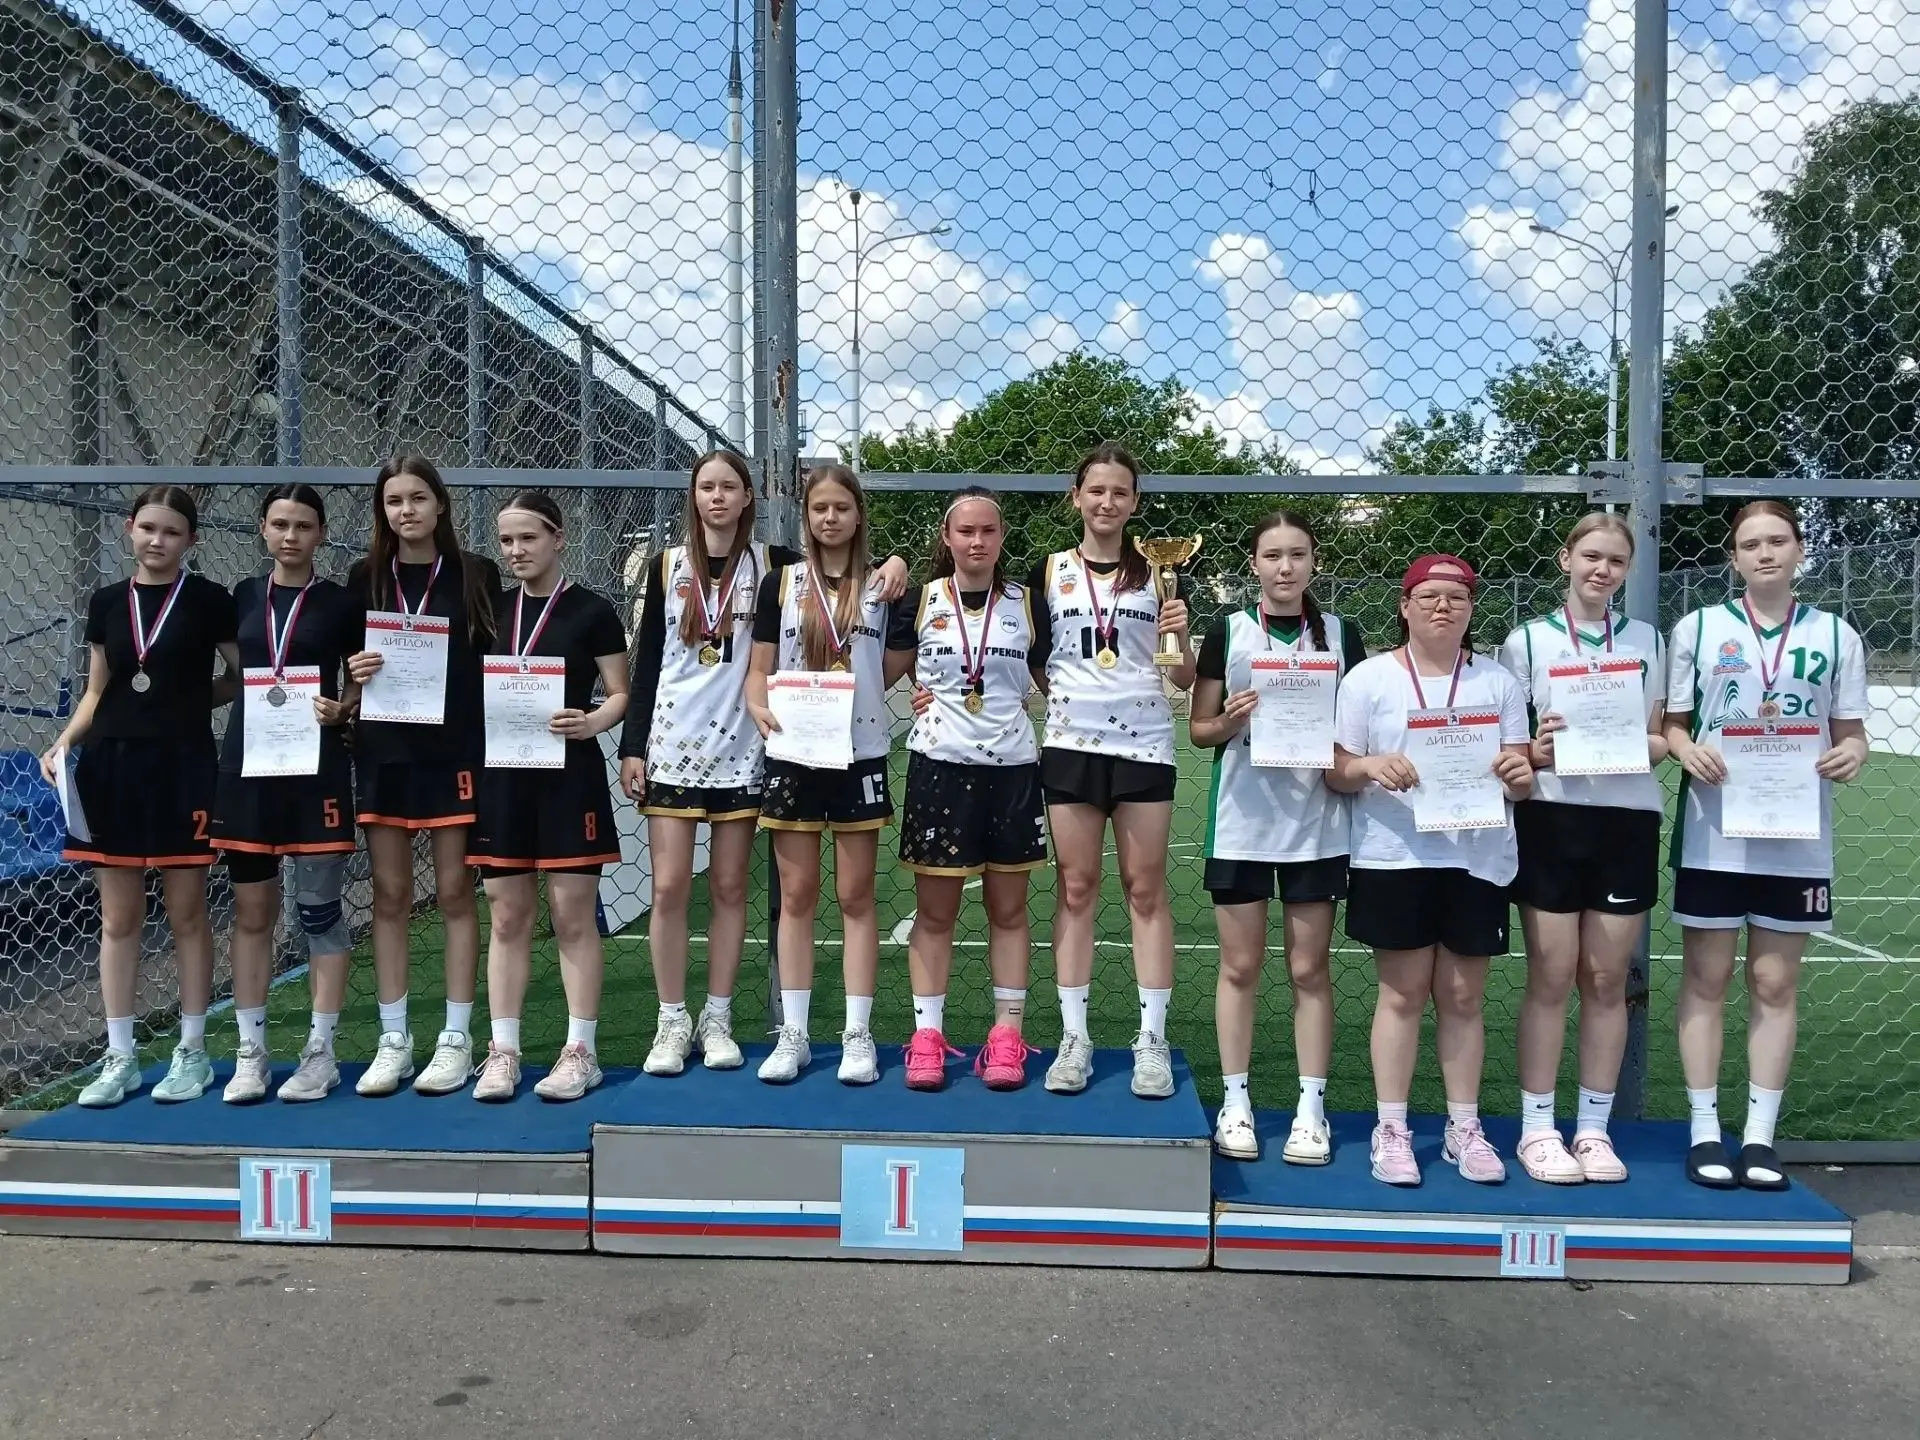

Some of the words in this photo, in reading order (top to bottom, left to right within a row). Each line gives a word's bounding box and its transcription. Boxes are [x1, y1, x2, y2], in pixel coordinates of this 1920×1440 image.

[1063, 608, 1083, 618] ИМ.
[380, 637, 434, 649] ДИПЛОМ
[936, 646, 957, 656] ИМ.
[1788, 647, 1828, 686] 12
[498, 681, 550, 692] ДИПЛОМ
[1266, 677, 1321, 688] ДИПЛОМ
[1567, 680, 1626, 695] ДИПЛОМ
[788, 693, 839, 704] ДИПЛОМ
[1425, 733, 1484, 746] ДИПЛОМ
[1739, 743, 1802, 753] ДИПЛОМ
[457, 770, 473, 800] 9
[323, 798, 340, 828] 5
[192, 810, 209, 840] 2
[585, 812, 597, 841] 8
[1802, 886, 1829, 913] 18
[251, 1162, 320, 1236] II
[885, 1159, 920, 1236] I
[1505, 1230, 1562, 1267] III
